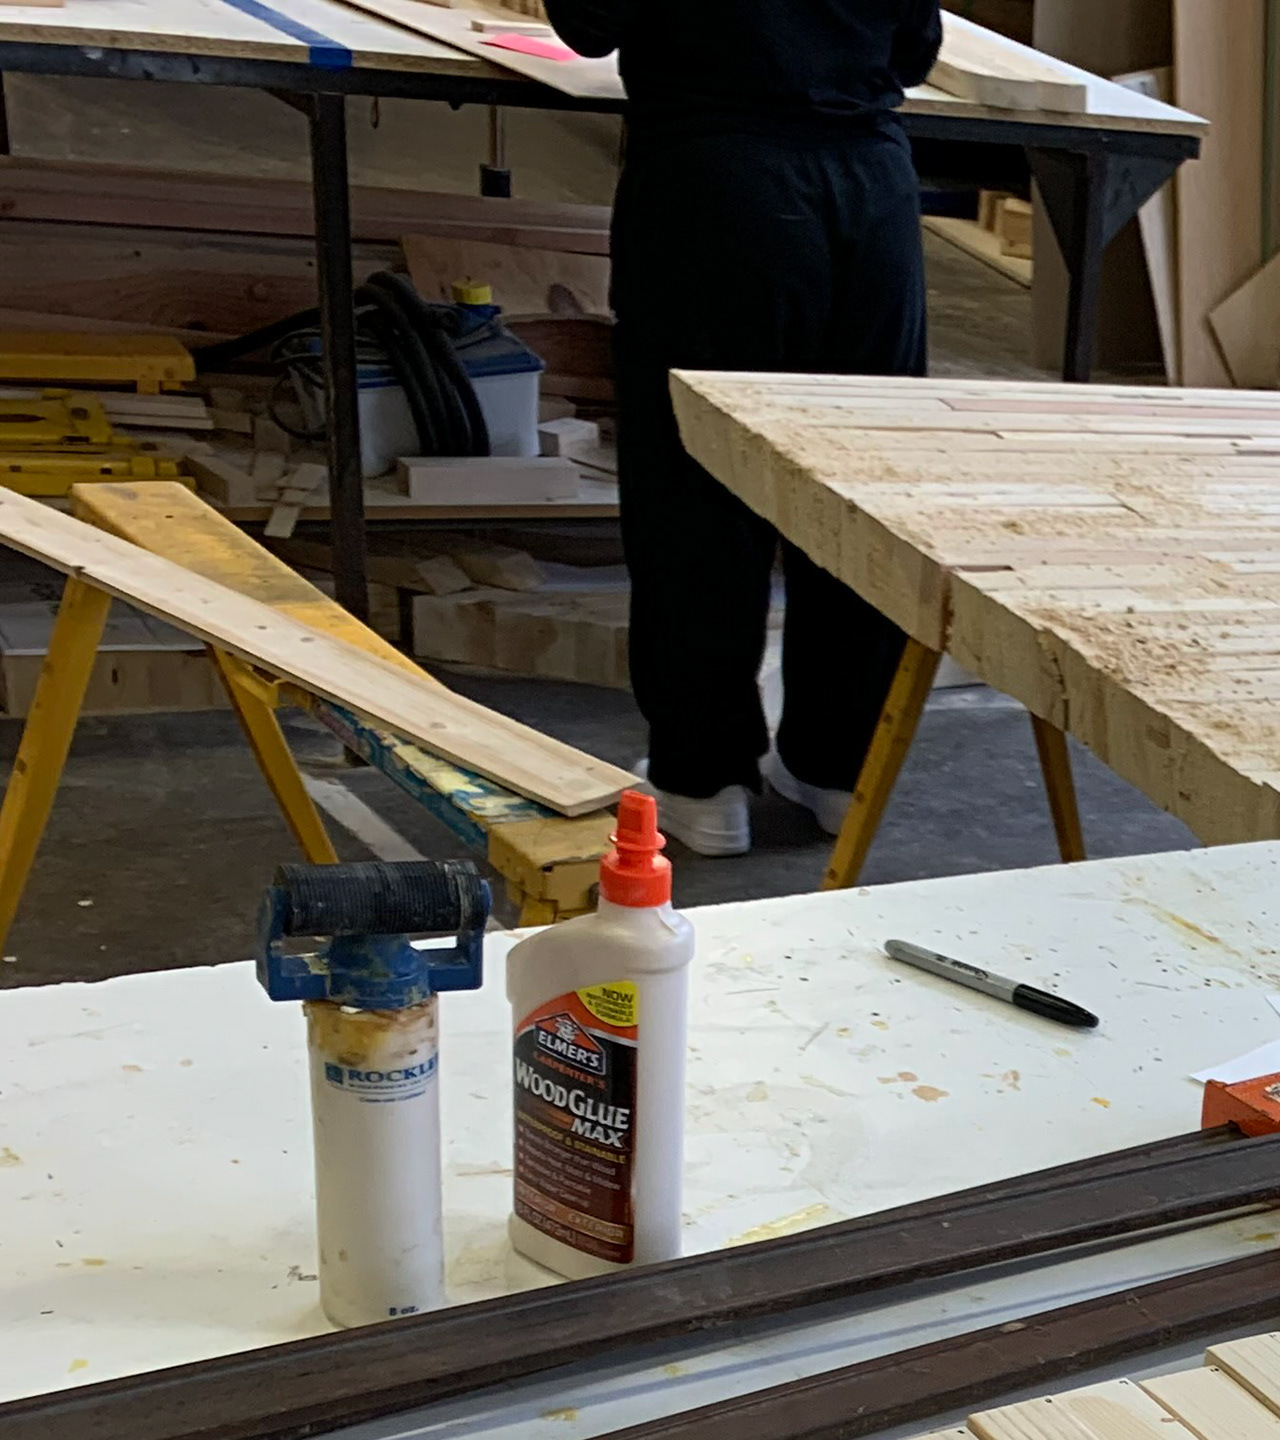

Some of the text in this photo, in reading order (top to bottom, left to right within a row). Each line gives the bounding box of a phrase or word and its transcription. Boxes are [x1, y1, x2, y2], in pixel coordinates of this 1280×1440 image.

[602, 987, 633, 1004] NOW
[538, 1030, 600, 1068] ELMER'S
[571, 1117, 625, 1148] MAX
